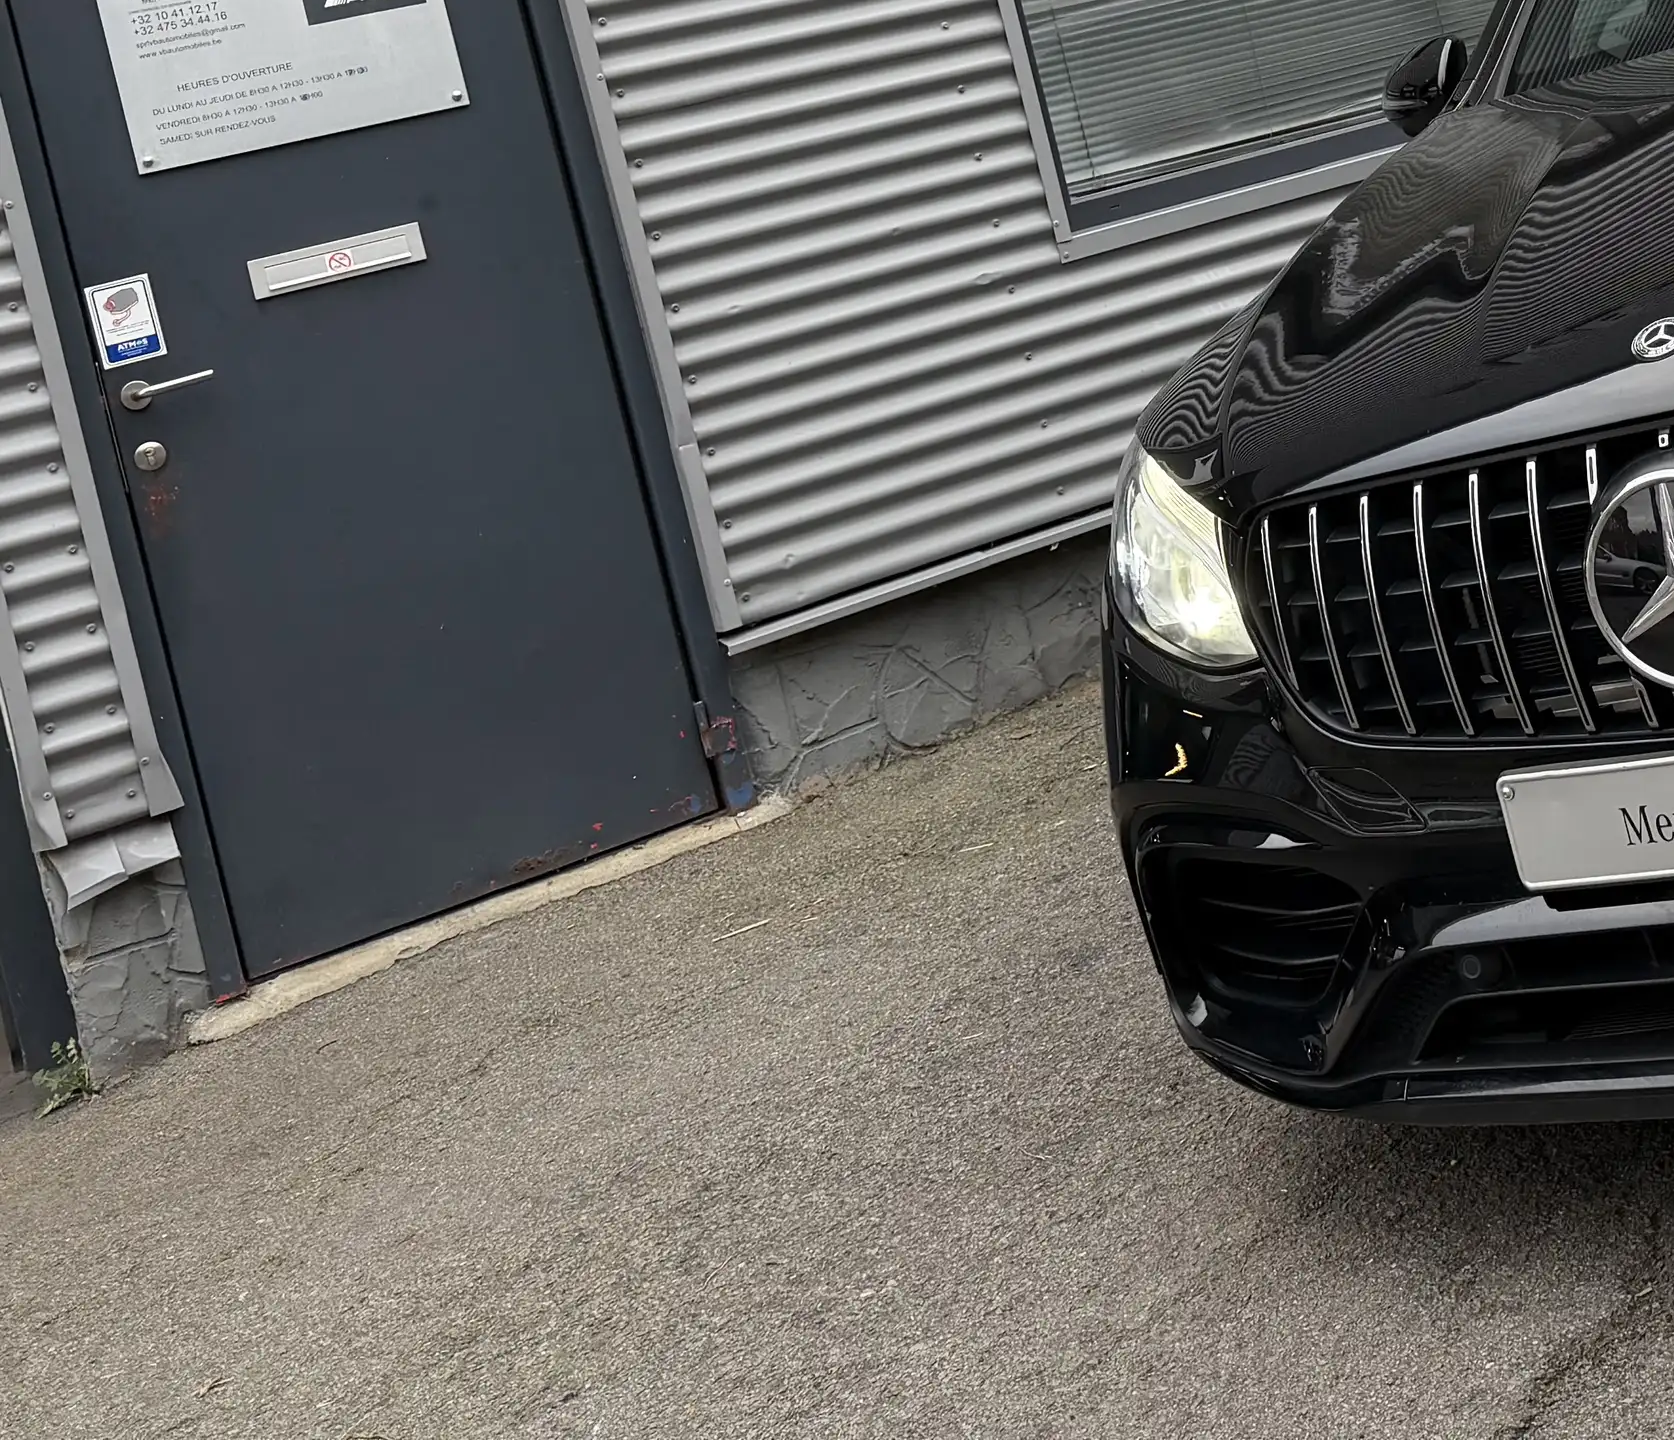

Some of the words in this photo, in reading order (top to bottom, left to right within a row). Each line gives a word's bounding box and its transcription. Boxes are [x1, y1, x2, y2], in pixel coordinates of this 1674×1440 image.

[131, 13, 151, 26] +32
[155, 10, 168, 22] 10
[171, 1, 218, 18] 41.12.17
[134, 24, 154, 36] +32
[157, 19, 178, 33] 475
[181, 11, 228, 28] 34.44.16
[177, 76, 219, 92] HEURES
[222, 61, 293, 84] D'OUVERTURE
[152, 107, 166, 116] DU
[167, 101, 193, 113] LUNDI
[195, 98, 207, 107] AU
[209, 93, 234, 105] JEUDI
[235, 90, 248, 100] DE
[271, 84, 279, 92] A
[155, 116, 201, 131] VENDREDI
[224, 109, 231, 117] A
[291, 95, 298, 103] A
[159, 133, 194, 146] SAMEDI
[194, 128, 213, 139] SUR
[215, 115, 276, 135] RENDEZ-VOUS
